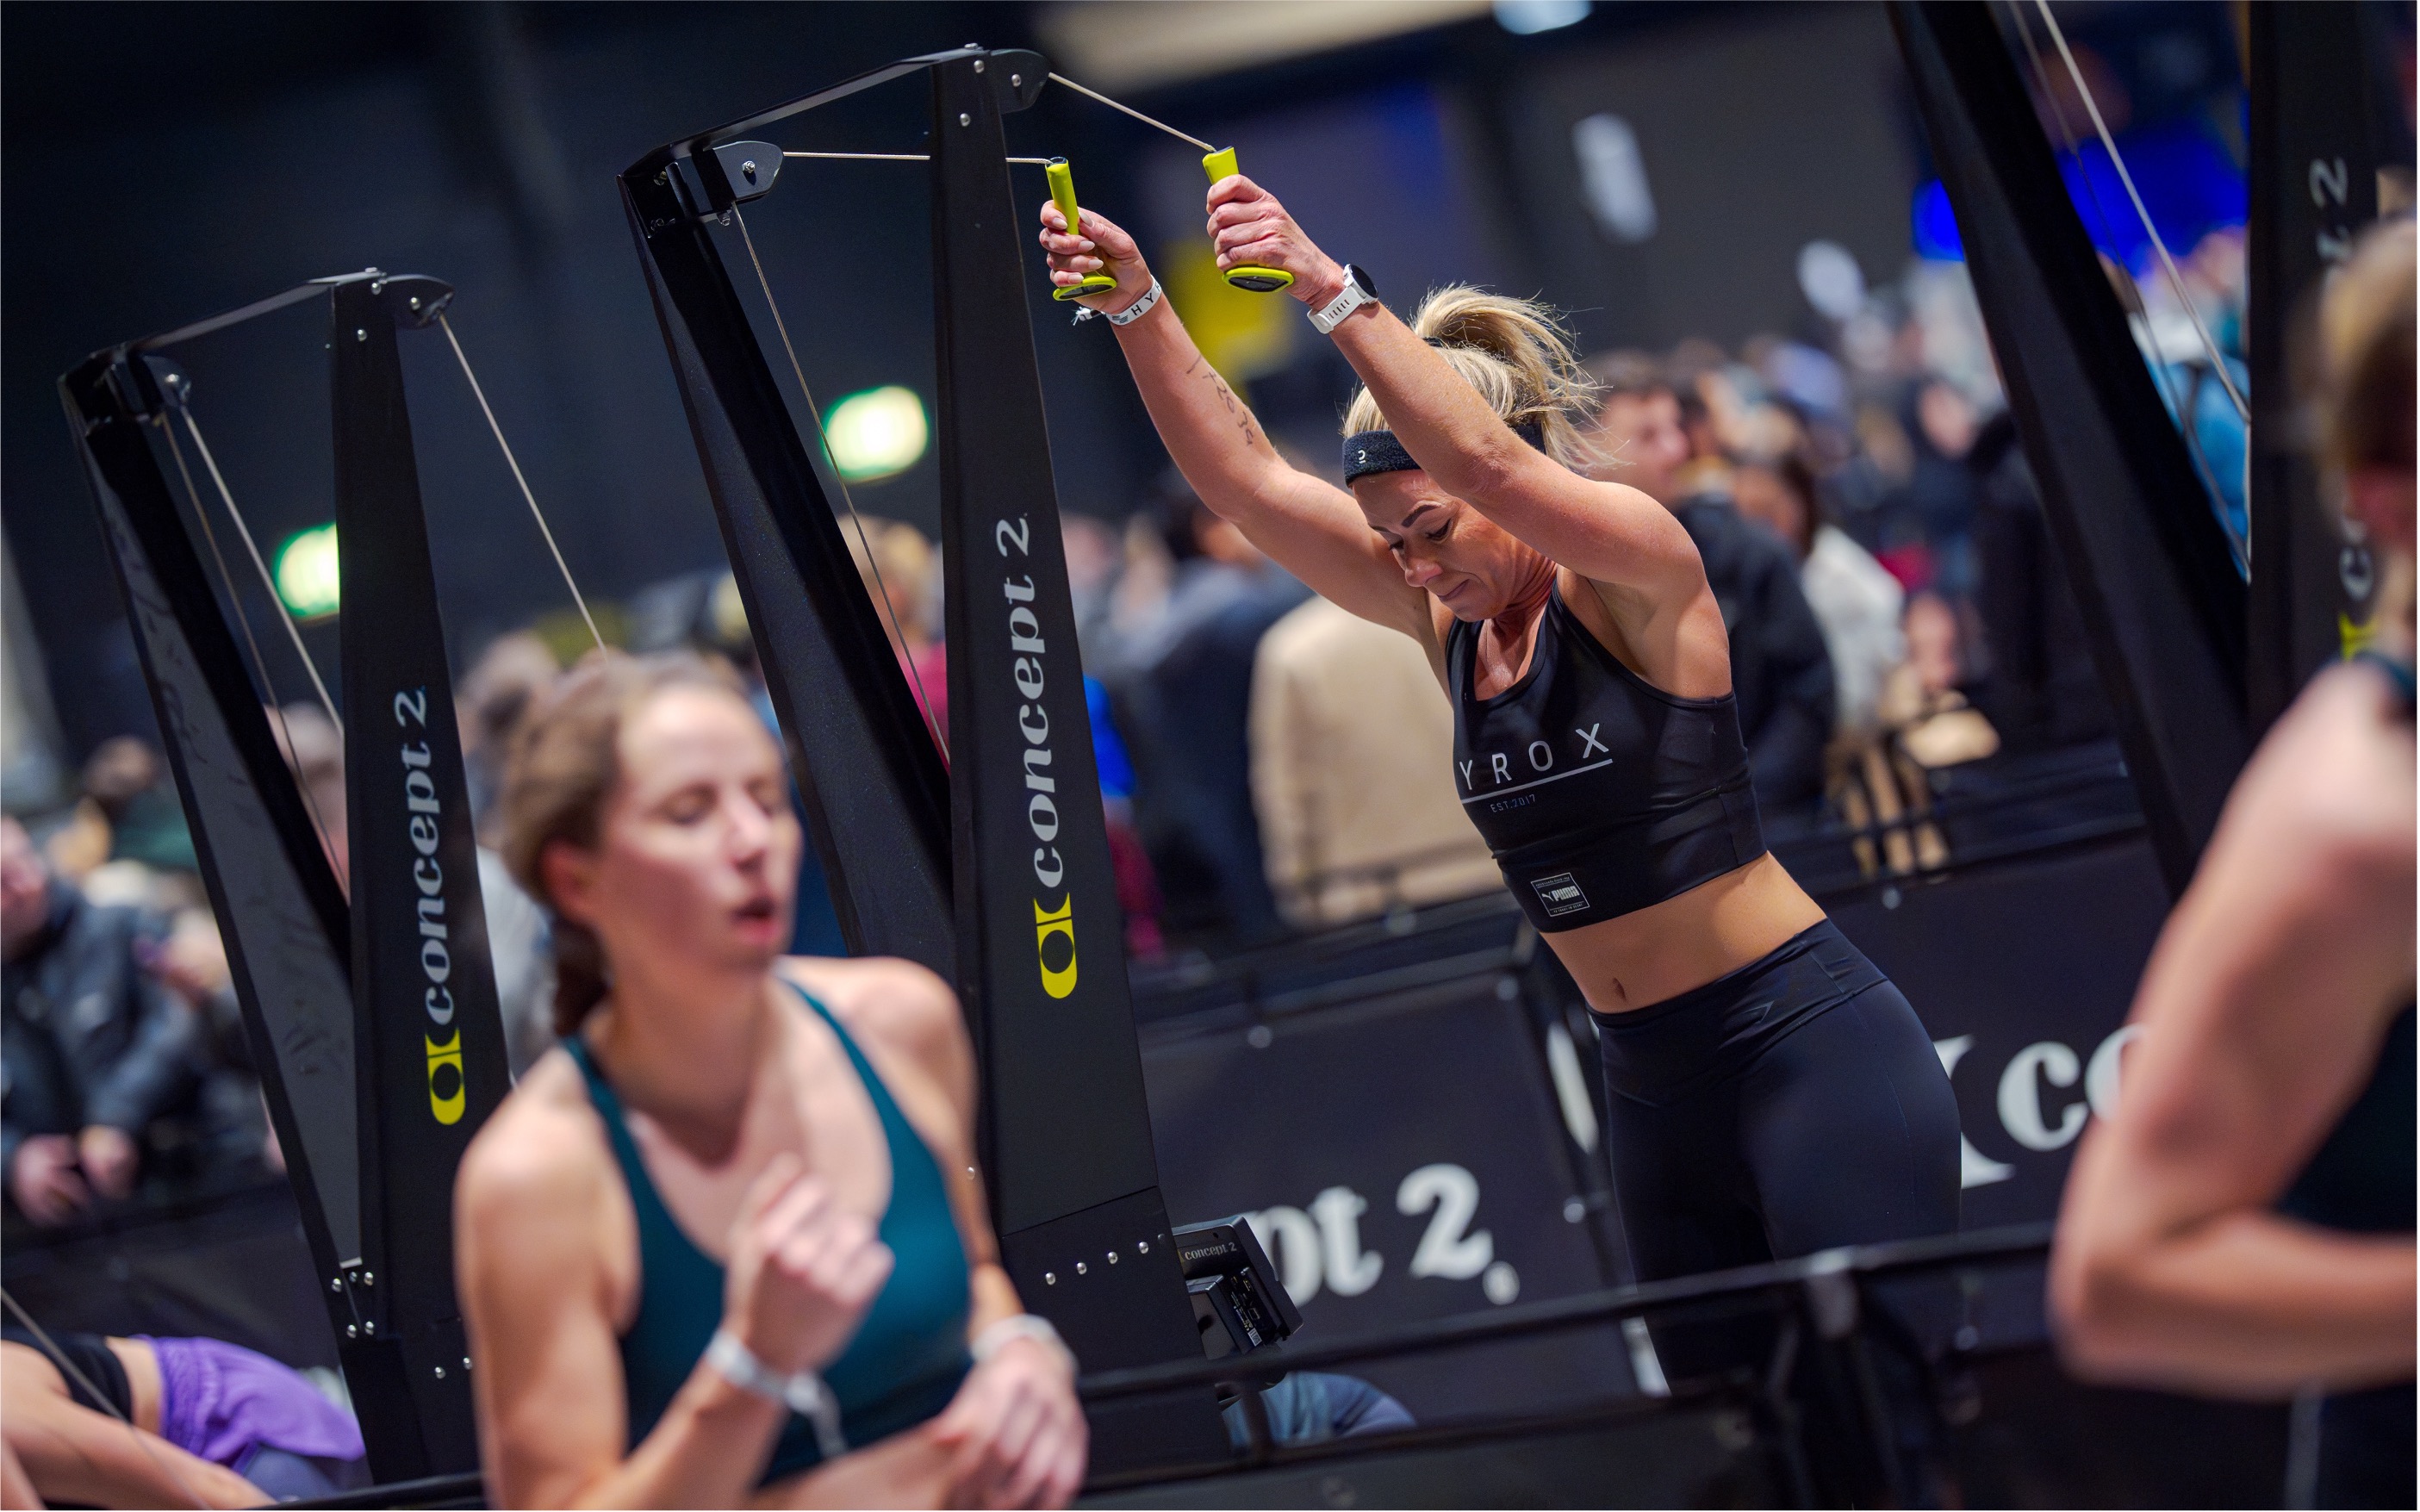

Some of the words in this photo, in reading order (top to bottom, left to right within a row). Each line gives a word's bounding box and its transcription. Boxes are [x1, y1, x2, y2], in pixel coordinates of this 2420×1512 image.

[996, 518, 1030, 557] 2
[394, 690, 426, 728] 2
[1004, 575, 1065, 888] concept
[401, 740, 455, 1025] concept
[1185, 1243, 1228, 1260] concept
[1228, 1241, 1238, 1253] 2
